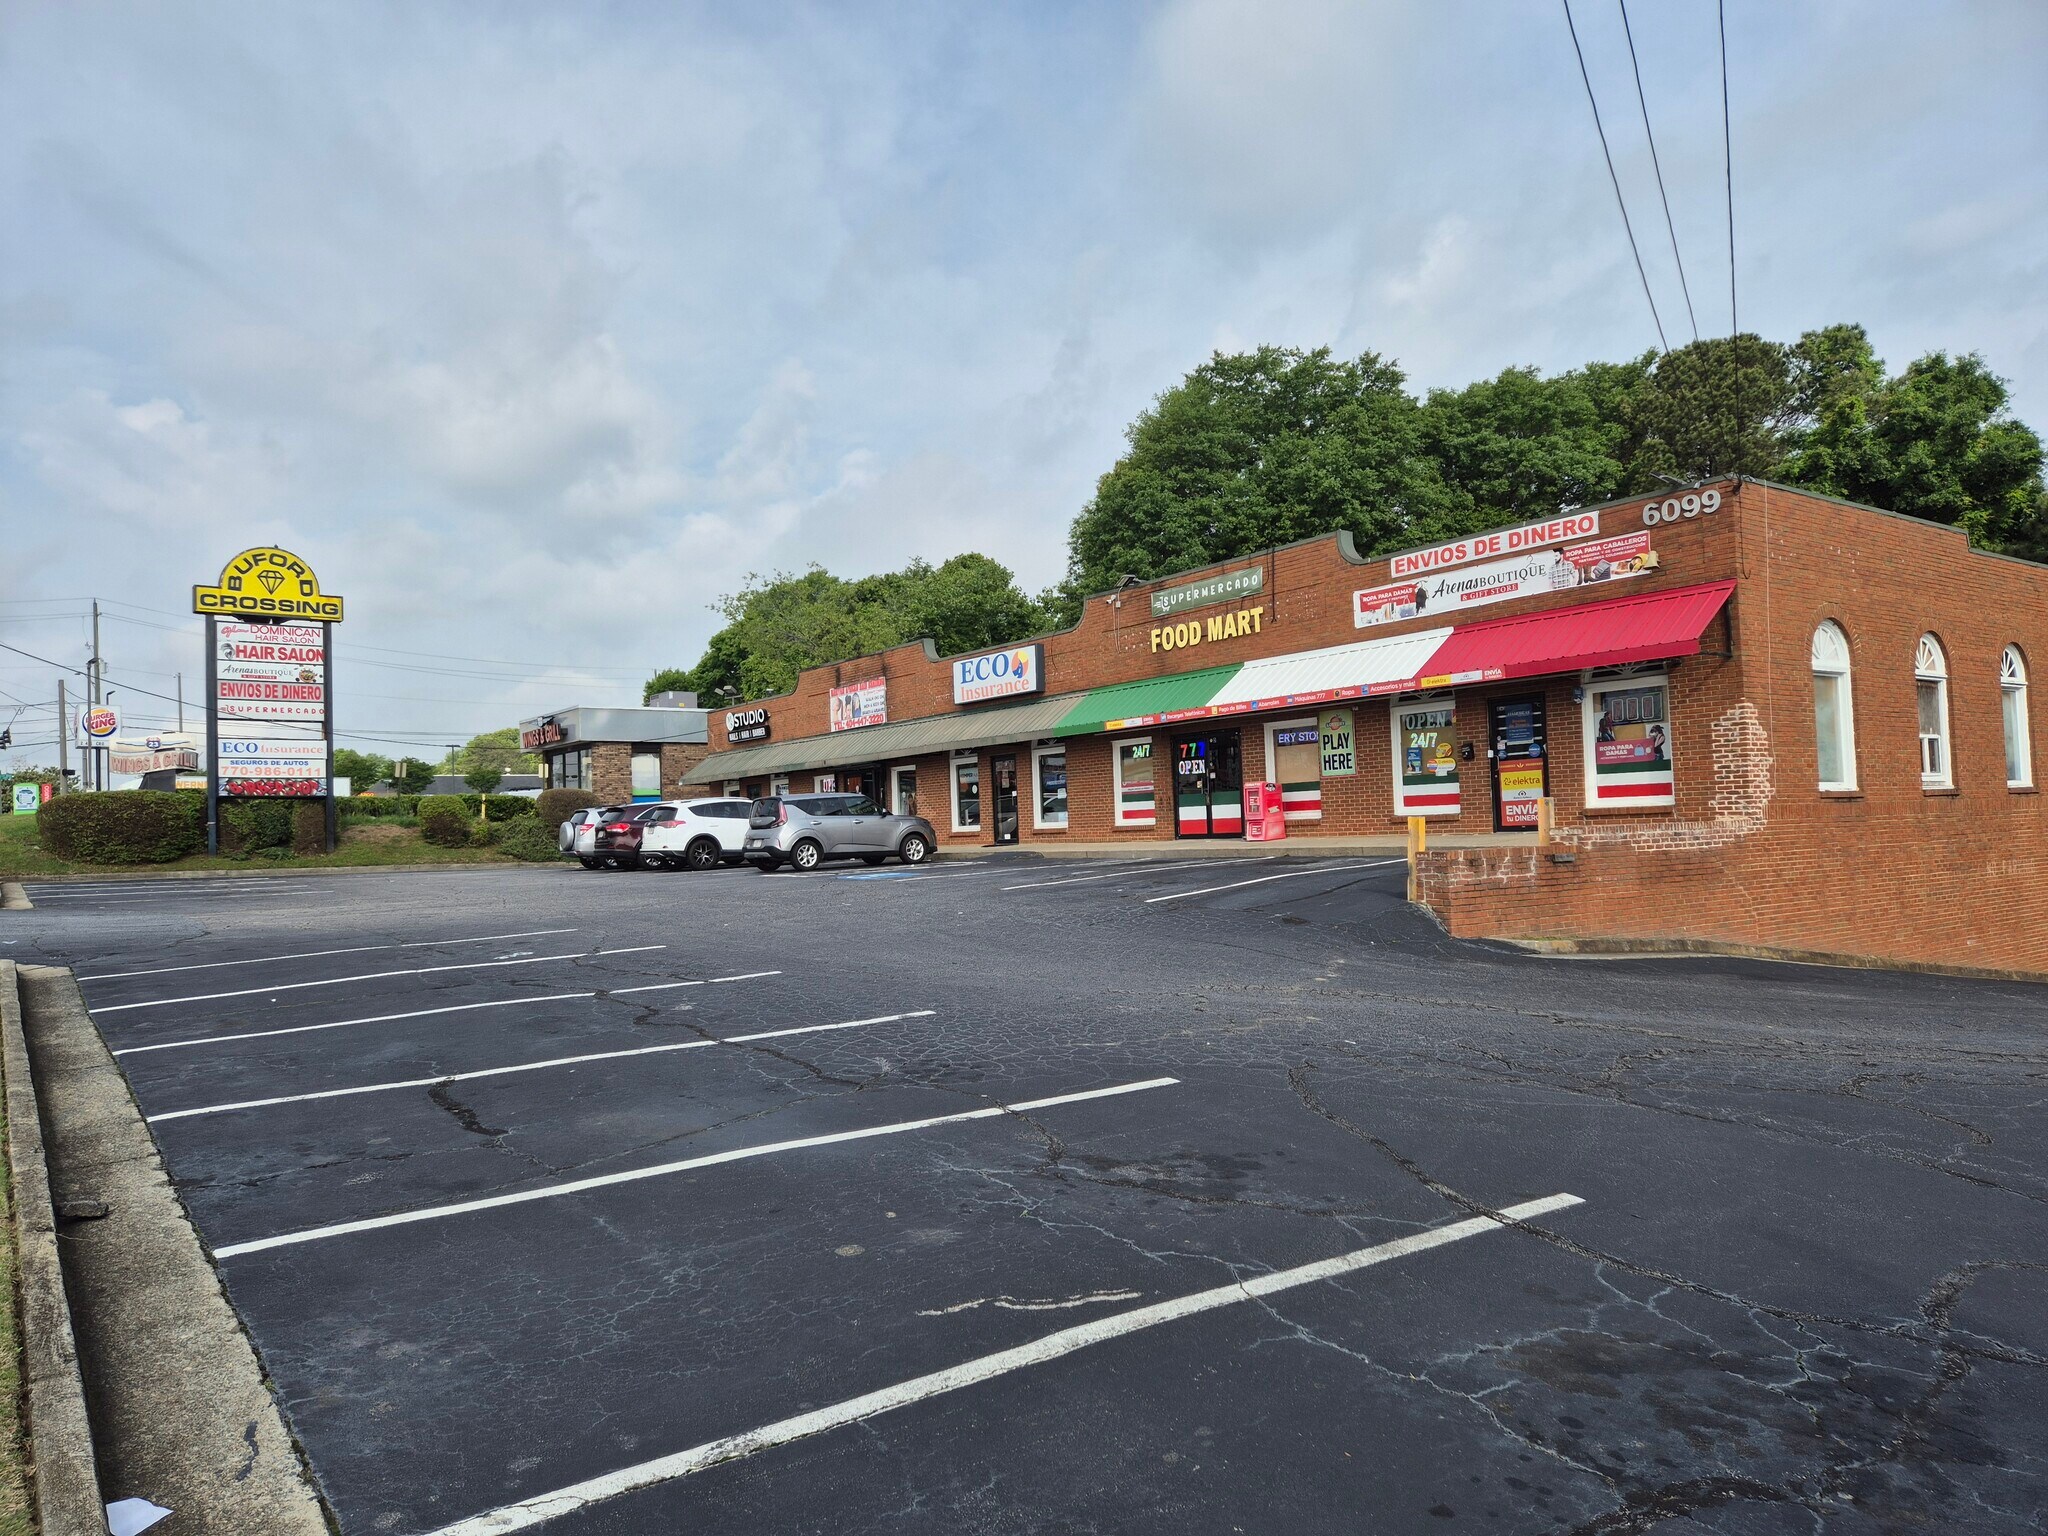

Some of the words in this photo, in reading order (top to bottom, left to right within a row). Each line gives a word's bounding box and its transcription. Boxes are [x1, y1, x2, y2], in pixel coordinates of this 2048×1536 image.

[1643, 490, 1721, 526] 6099
[1395, 544, 1467, 574] ENVIOS
[1474, 536, 1501, 556] DE
[1508, 515, 1594, 549] DINERO
[1566, 550, 1583, 558] ROPA
[1584, 546, 1601, 554] PARA
[1603, 535, 1647, 549] CABALLEROS
[227, 552, 313, 597] BUFORD
[1163, 574, 1258, 607] SUPERMERCADO
[1393, 588, 1413, 597] DAMAS
[1469, 590, 1488, 599] GIFT
[1490, 584, 1518, 596] STORE
[200, 594, 339, 616] CROSSING
[250, 625, 321, 638] DOMINICAN
[1151, 621, 1202, 653] FOOD
[1207, 606, 1264, 642] MART
[255, 635, 279, 643] HAIR
[282, 636, 315, 644] SALON
[235, 645, 276, 661] HAIR
[278, 646, 325, 662] SALON
[960, 653, 1010, 684] ECO
[220, 682, 262, 698] ENVIOS
[264, 684, 279, 699] DE
[282, 685, 322, 700] DINERO
[961, 678, 1030, 701] Insurance
[1342, 689, 1355, 697] Ropa
[1370, 684, 1399, 693] Accesorios
[230, 705, 325, 715] SUPERMERCADO
[734, 708, 765, 728] STUDIO
[1405, 711, 1447, 730] OPEN
[1278, 732, 1297, 743] ERY
[1322, 732, 1350, 751] PLAY
[1410, 732, 1438, 748] 24/7
[222, 742, 258, 753] ECO
[260, 744, 324, 754] Insurance
[1132, 744, 1150, 759] 24/7
[111, 756, 150, 772] WINGS
[152, 753, 161, 769] &
[1178, 759, 1206, 775] OPEN
[1323, 752, 1353, 771] HERE
[221, 766, 321, 777] 770-986-0111
[1512, 776, 1541, 786] elektra
[1505, 801, 1538, 816] ENVÍA
